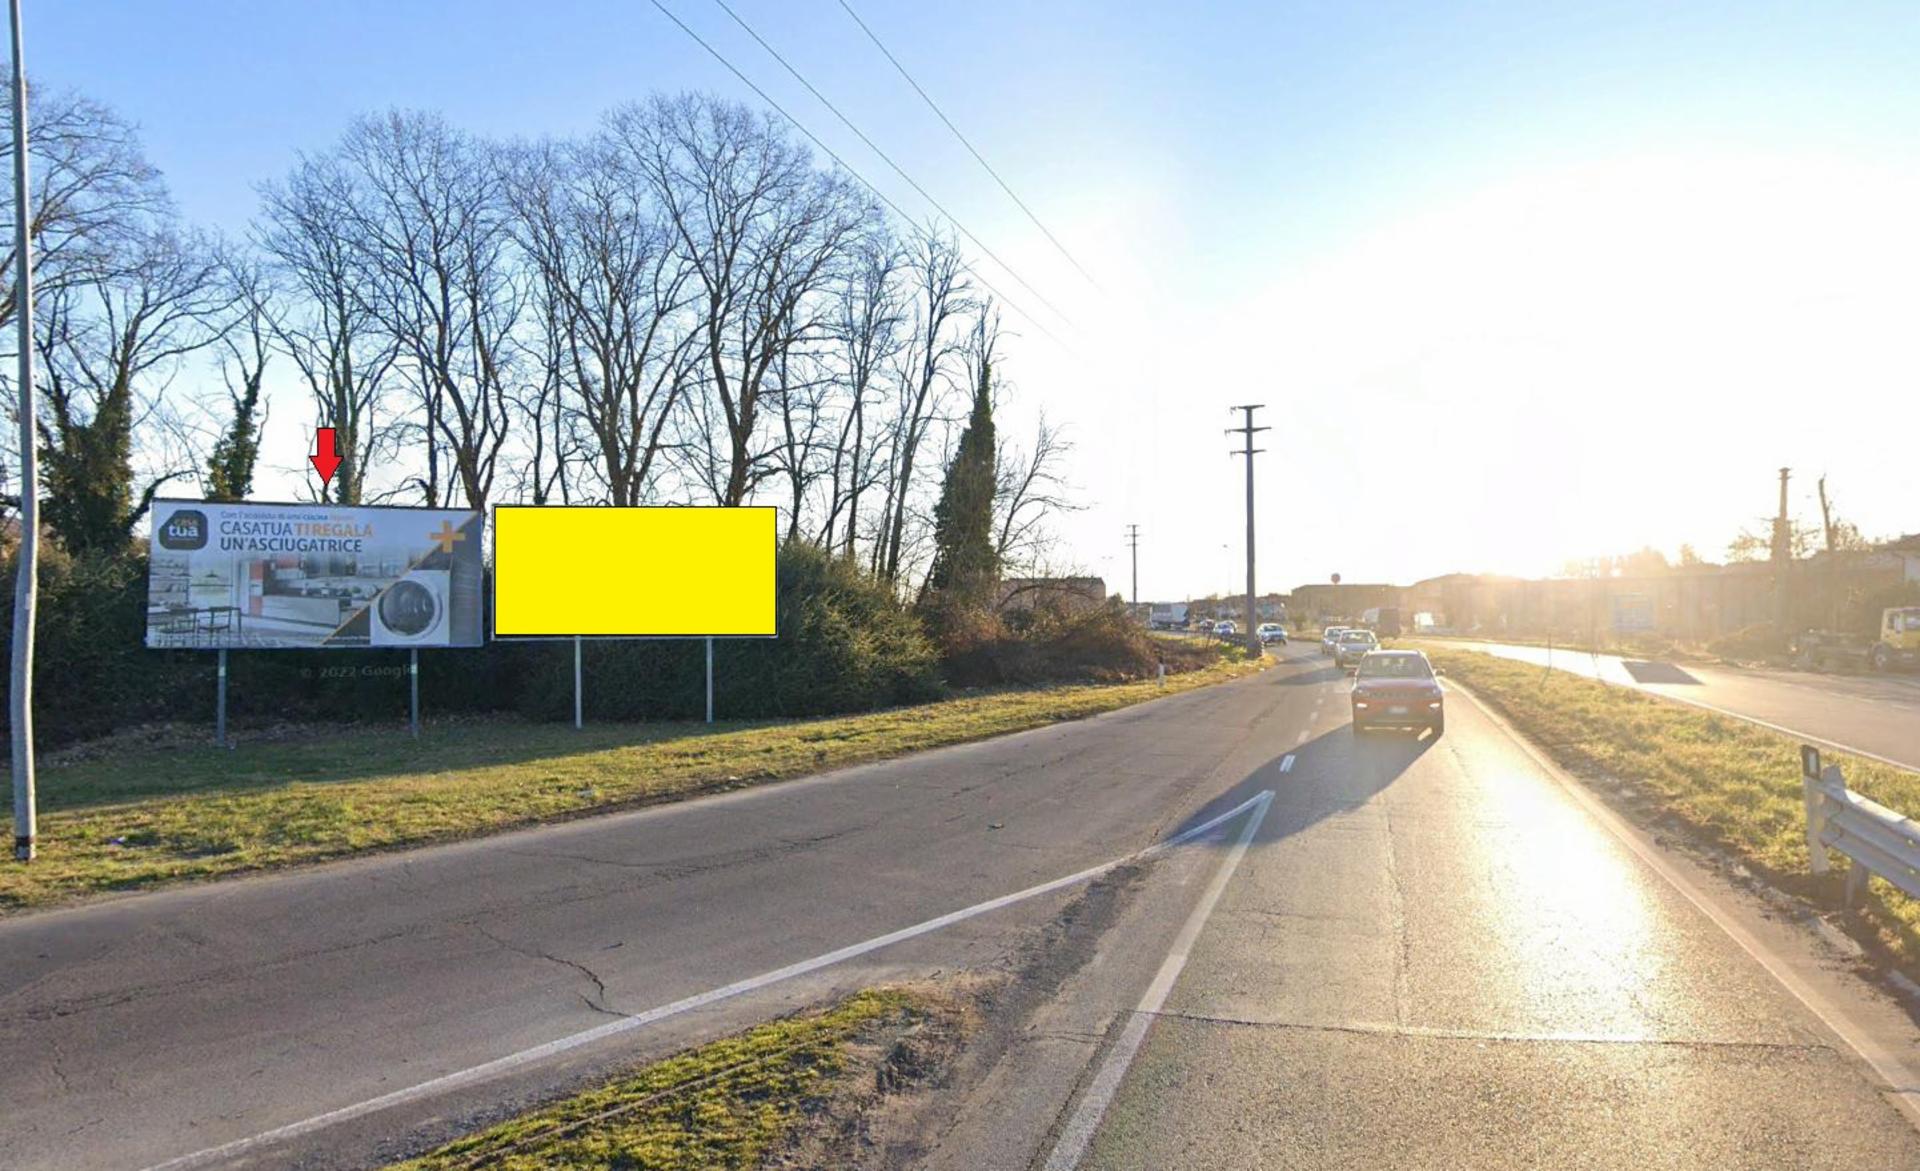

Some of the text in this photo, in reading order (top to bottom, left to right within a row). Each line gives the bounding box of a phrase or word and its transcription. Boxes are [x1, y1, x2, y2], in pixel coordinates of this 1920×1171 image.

[168, 525, 199, 537] tua
[220, 521, 293, 536] CASATUA
[220, 537, 362, 552] UN'ASCIUGATRICE
